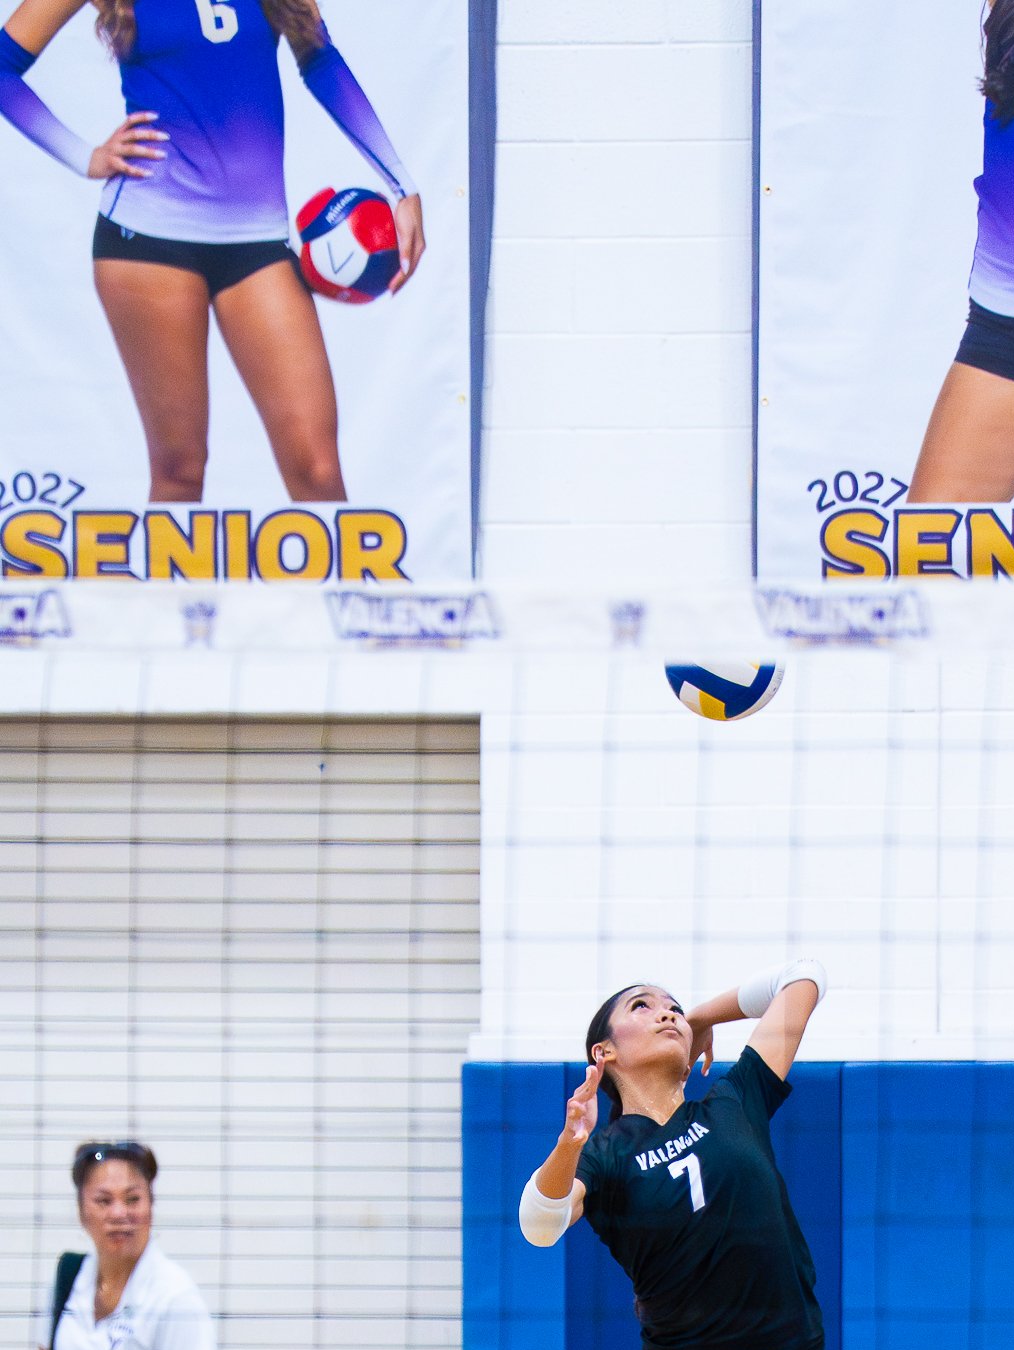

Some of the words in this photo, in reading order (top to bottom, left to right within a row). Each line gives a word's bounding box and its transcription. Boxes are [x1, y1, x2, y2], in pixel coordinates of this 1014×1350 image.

[194, 0, 239, 44] 6
[807, 470, 909, 513] 2027
[0, 508, 413, 583] SENIOR
[635, 1121, 710, 1171] VALENCIA
[667, 1152, 706, 1212] 7
